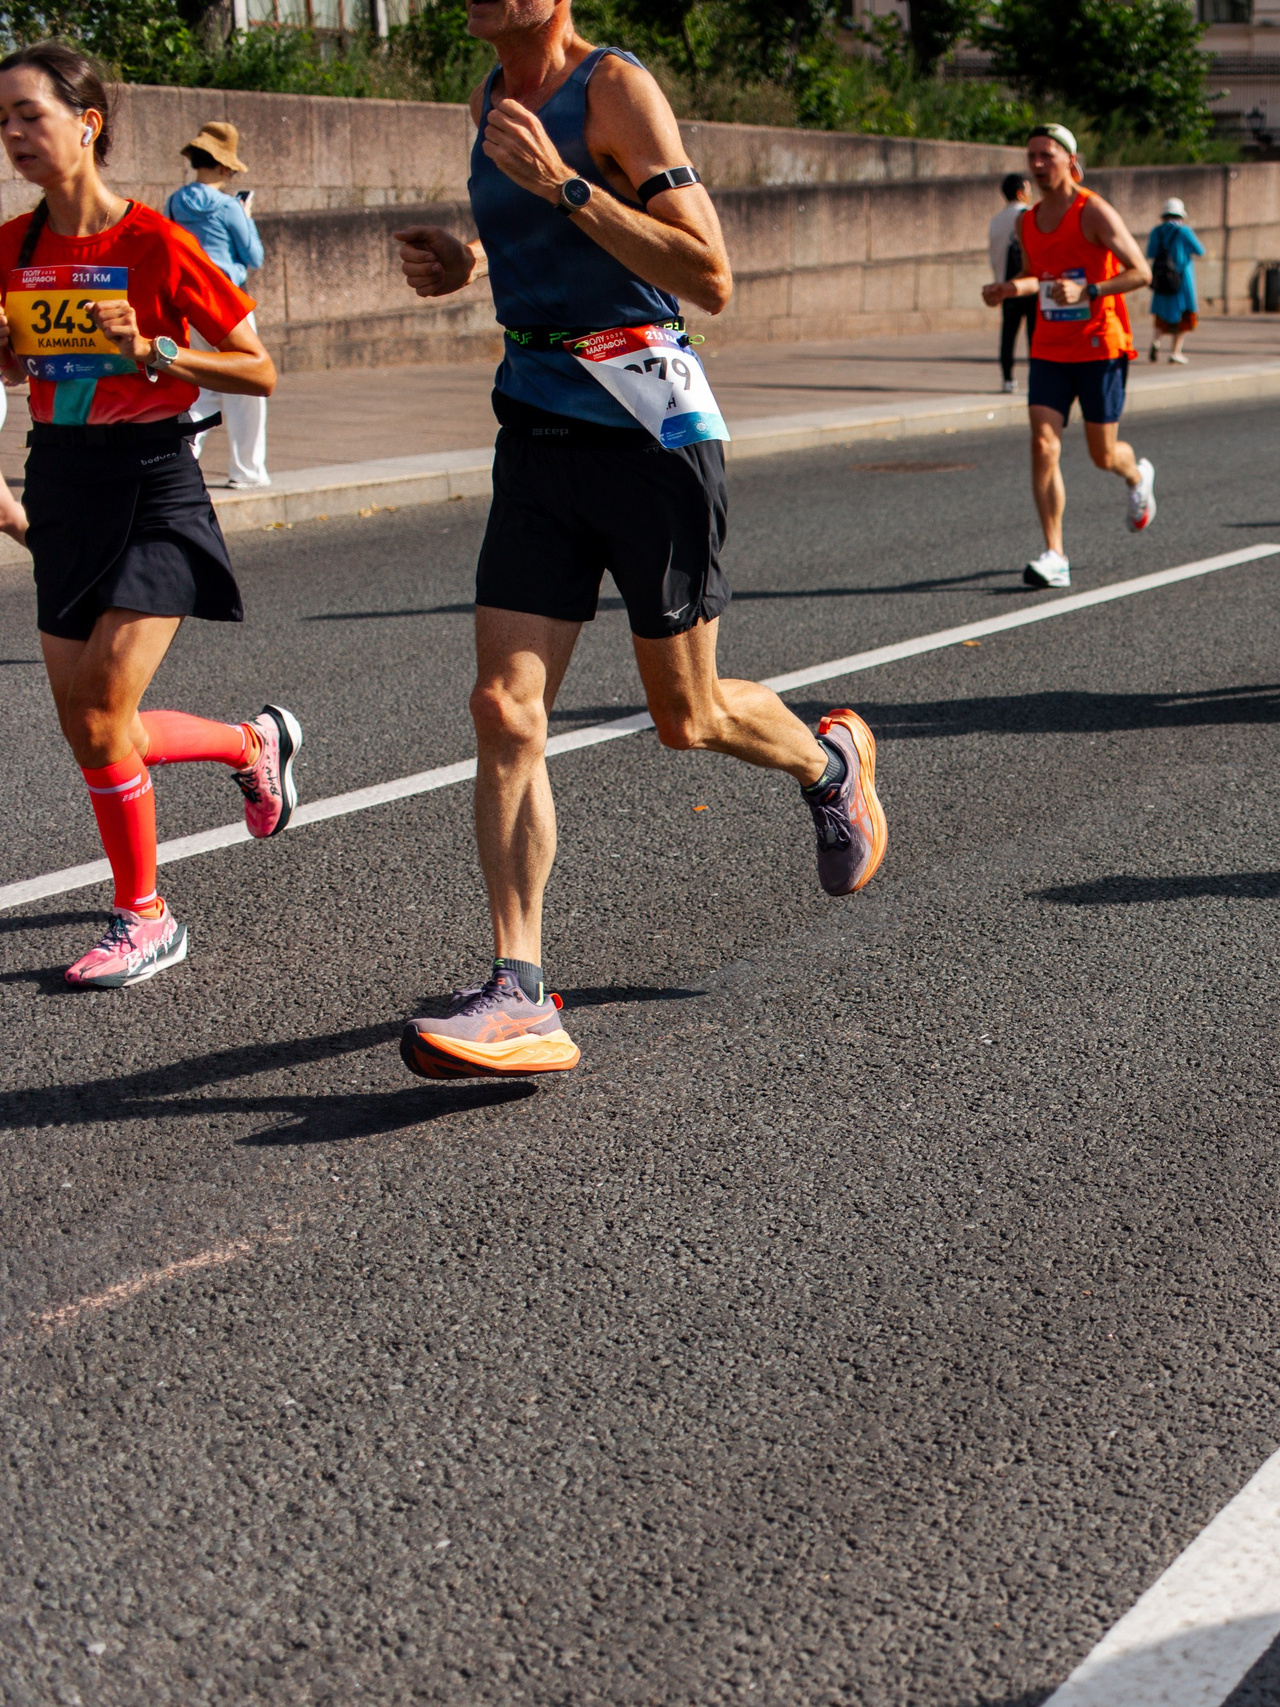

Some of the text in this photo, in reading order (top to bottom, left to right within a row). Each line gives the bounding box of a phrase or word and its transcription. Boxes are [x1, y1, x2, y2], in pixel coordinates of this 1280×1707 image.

[23, 269, 40, 278] ПОЛУ
[72, 273, 90, 283] 21,1
[22, 275, 56, 284] МАРАФОН
[31, 299, 98, 334] 343
[605, 331, 624, 340] 2026
[645, 330, 664, 341] 21,1
[38, 338, 96, 348] КАМИЛЛА
[585, 337, 627, 356] МАРАФОН
[544, 428, 569, 436] cep
